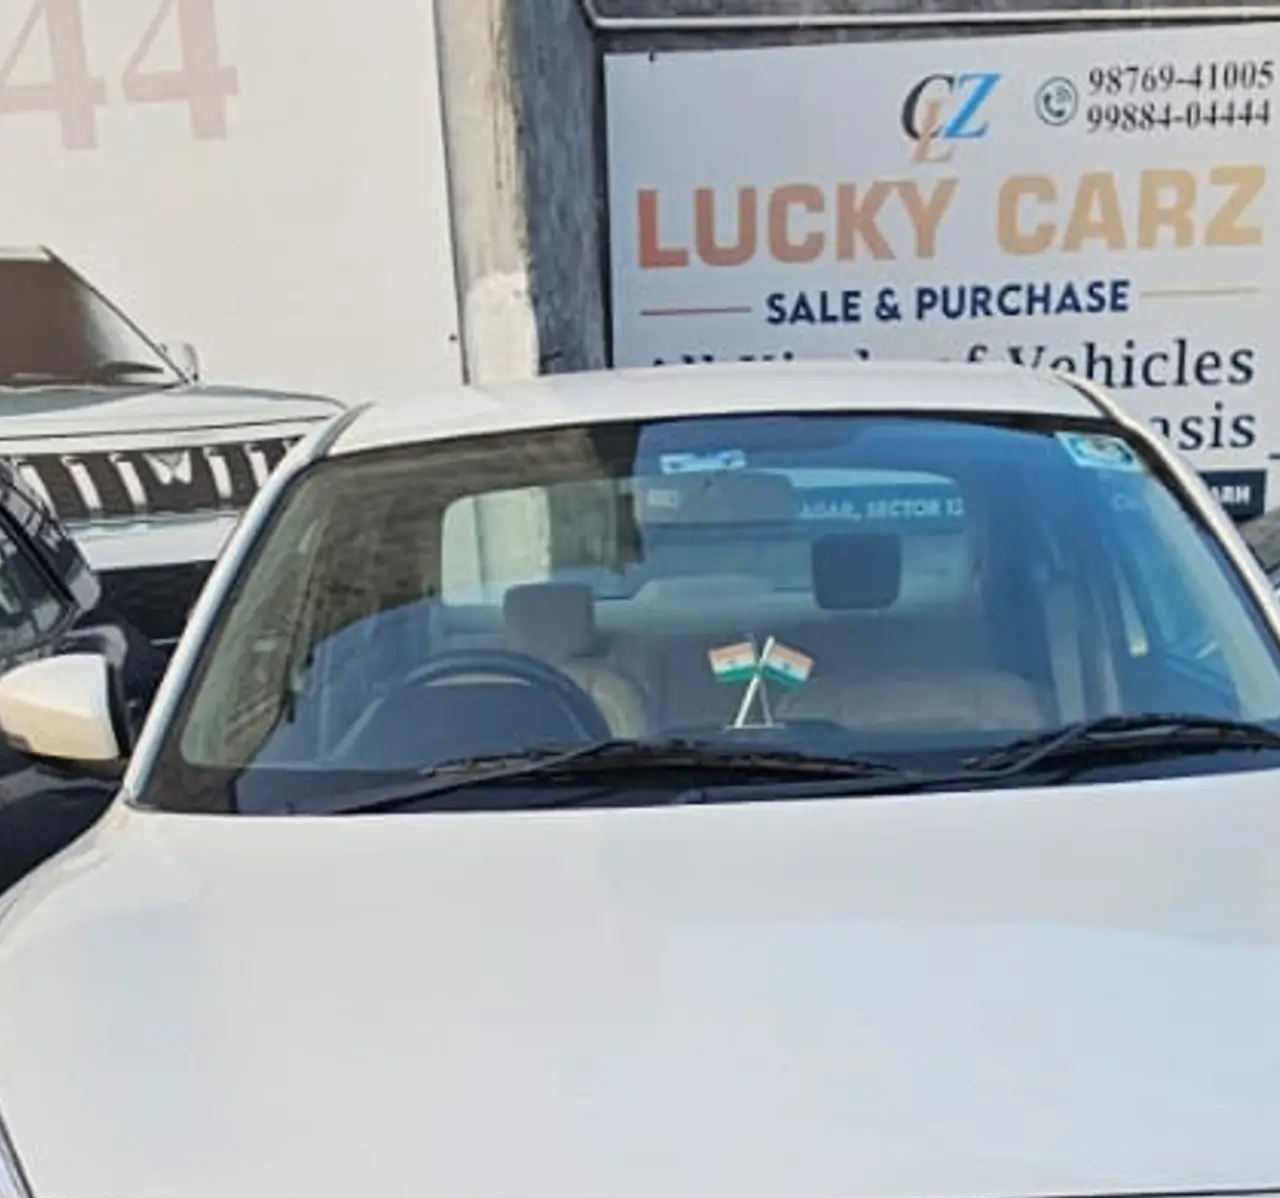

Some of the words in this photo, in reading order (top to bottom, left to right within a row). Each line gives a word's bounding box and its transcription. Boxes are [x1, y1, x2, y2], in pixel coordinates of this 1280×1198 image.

[1088, 60, 1275, 95] 98769-41005
[1086, 98, 1272, 134] 99884-04444
[637, 178, 958, 270] LUCKY
[995, 165, 1266, 257] CARZ
[765, 291, 862, 326] SALE
[874, 288, 904, 324] &
[915, 279, 1131, 322] PURCHASE
